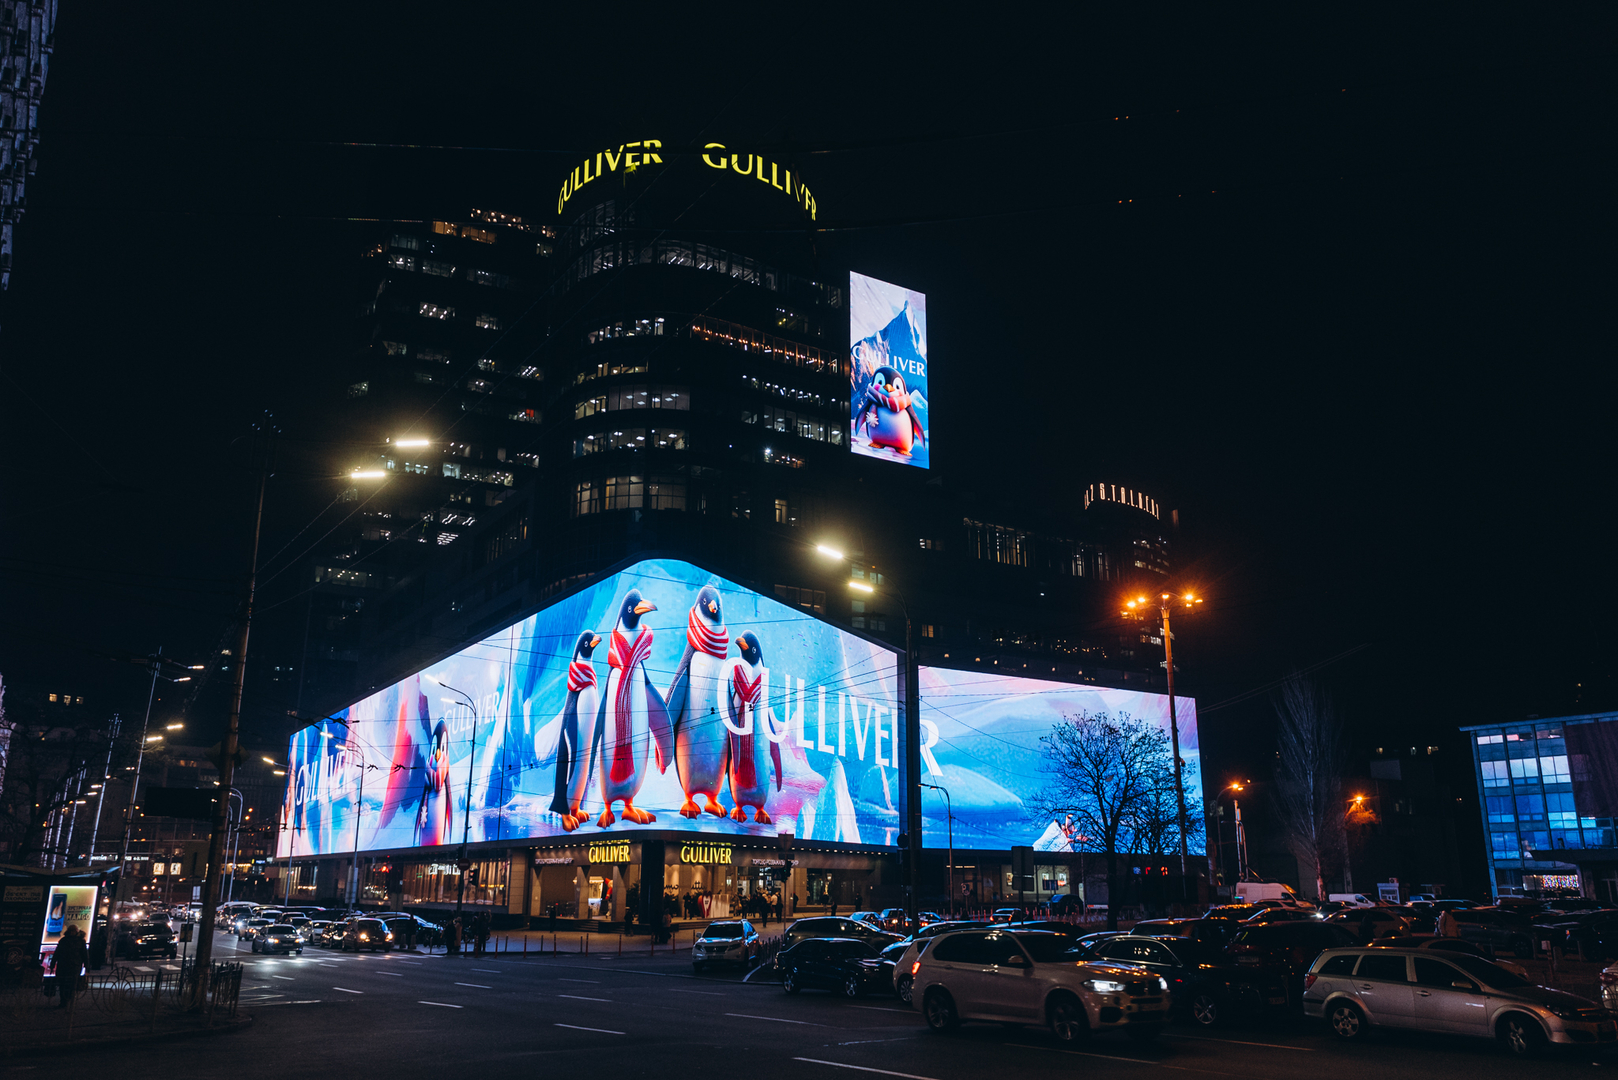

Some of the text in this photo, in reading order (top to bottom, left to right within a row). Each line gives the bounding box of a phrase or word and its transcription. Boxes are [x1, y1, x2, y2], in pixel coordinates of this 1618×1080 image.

[557, 139, 663, 215] GULLIVER
[852, 345, 926, 377] GULLIVER
[716, 656, 944, 777] GULLIVER
[588, 844, 631, 864] GULLIVER
[680, 845, 733, 865] GULLIVER
[66, 913, 91, 921] MANGO
